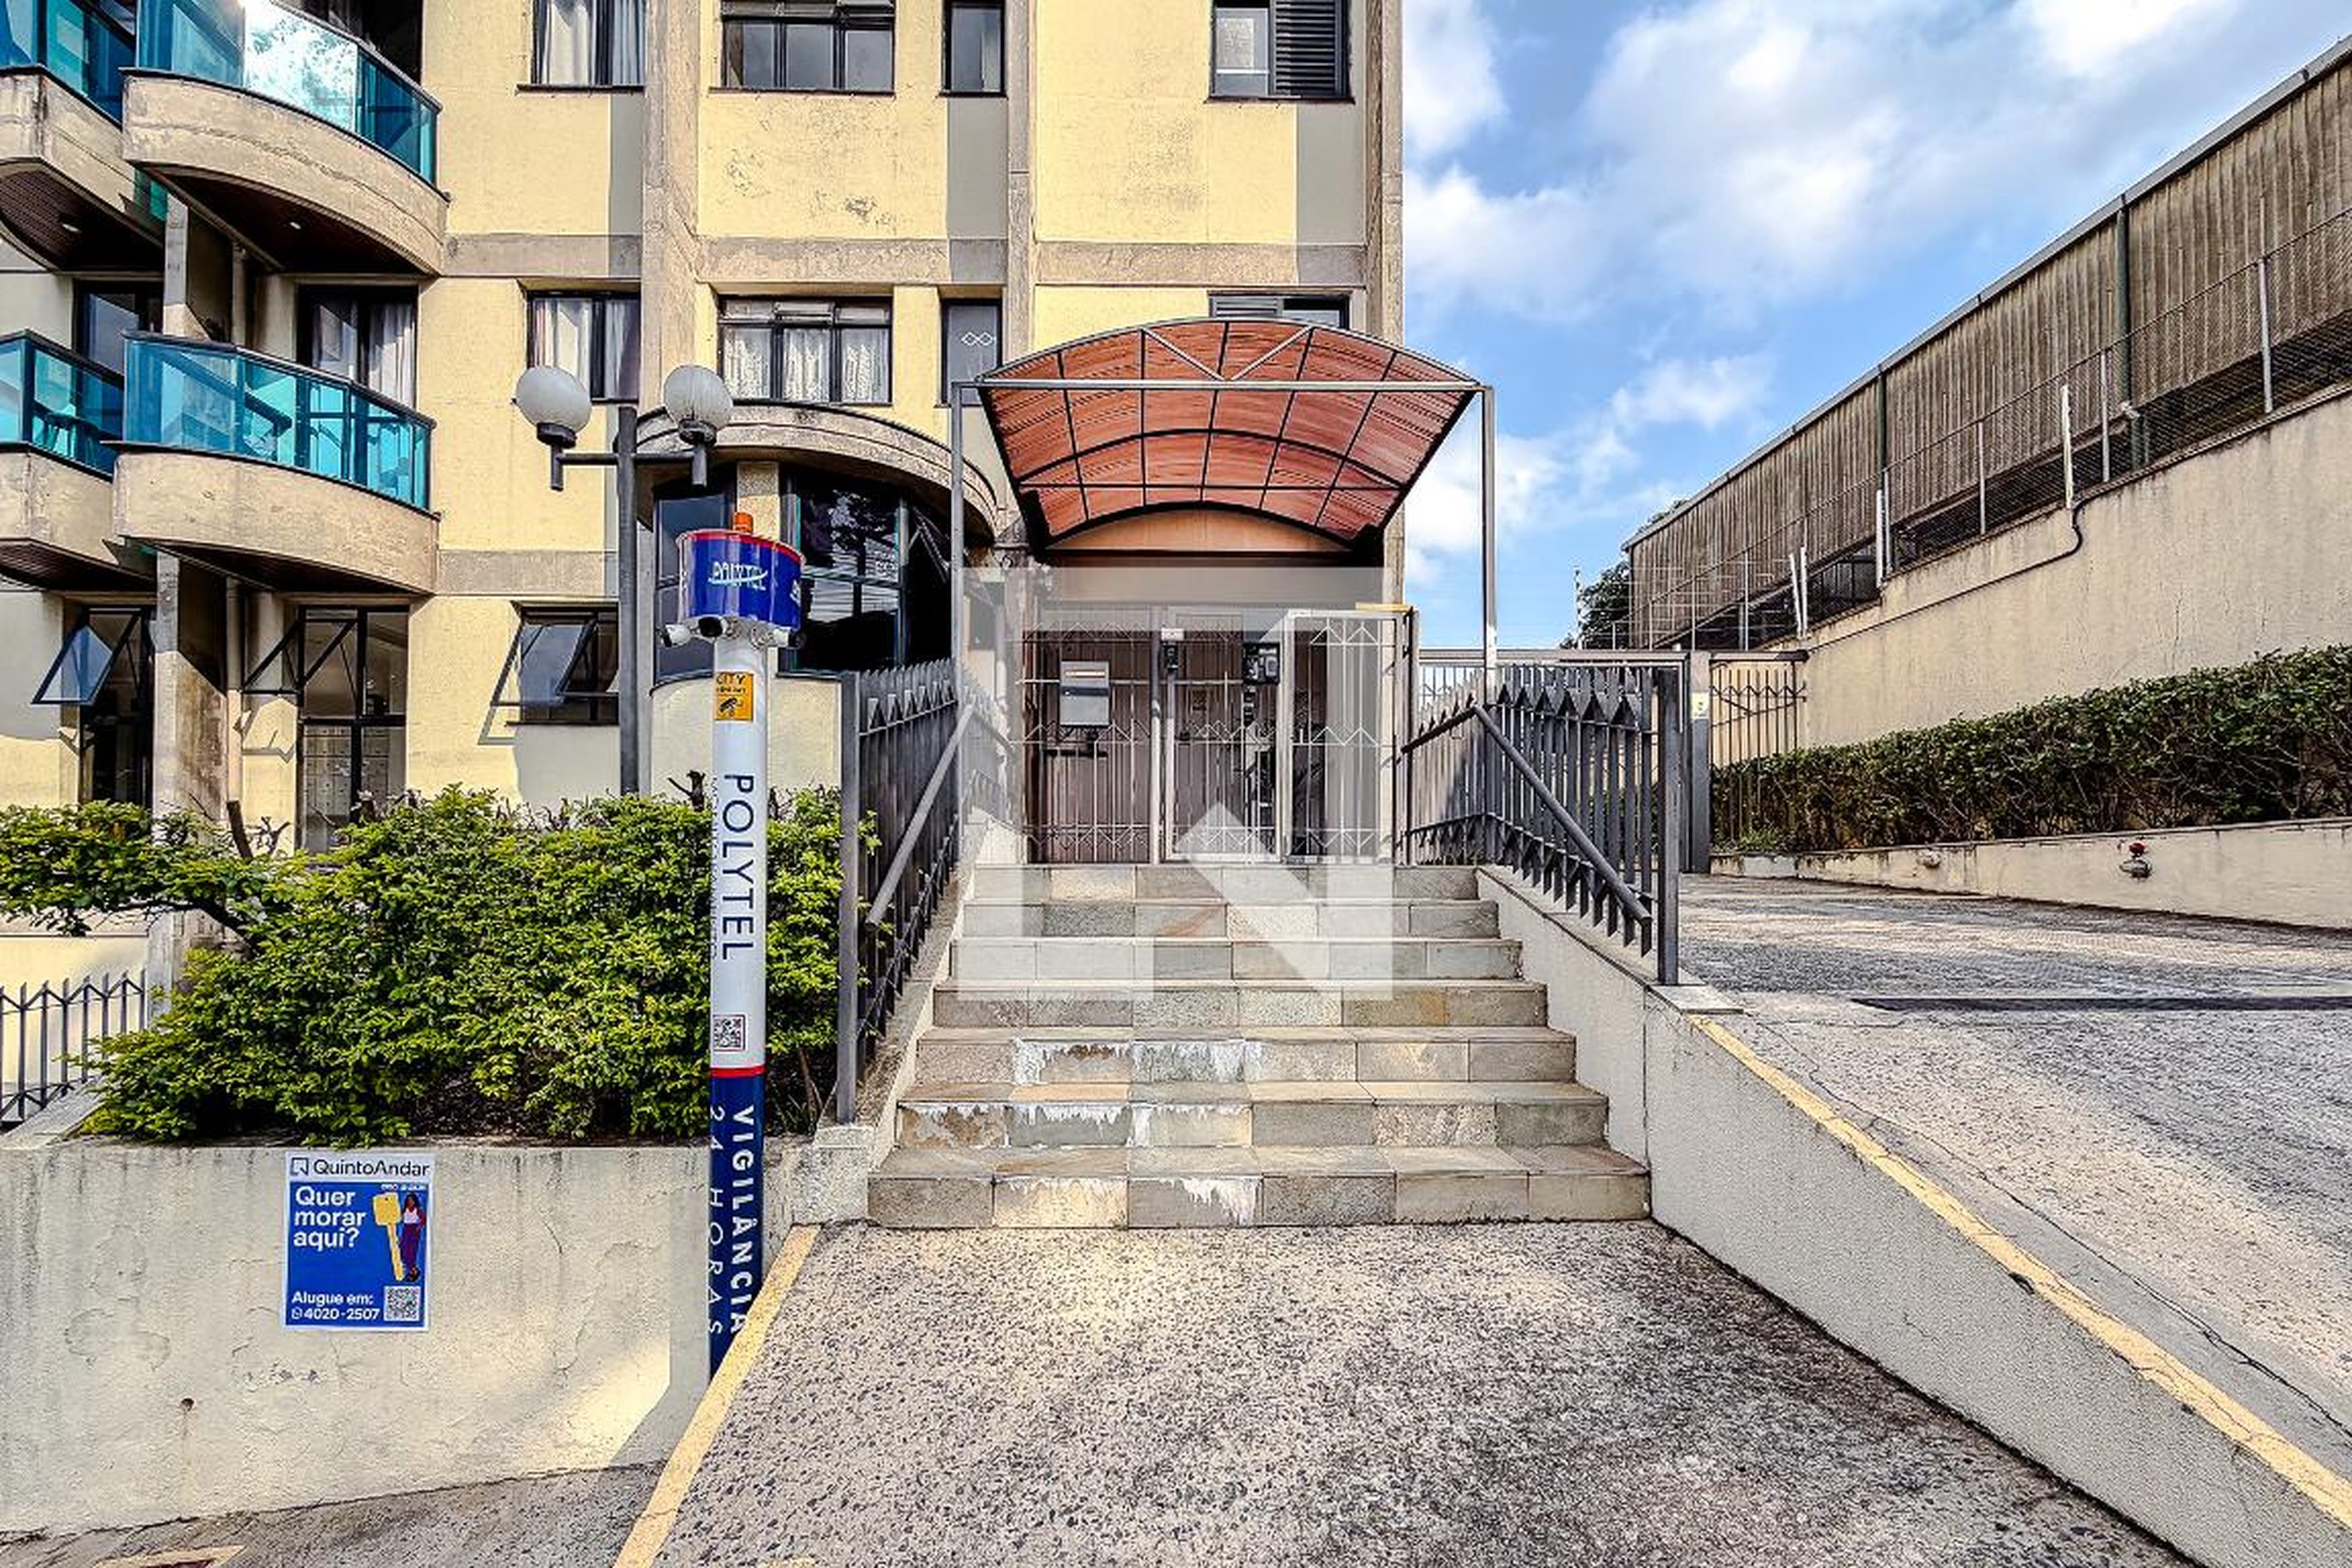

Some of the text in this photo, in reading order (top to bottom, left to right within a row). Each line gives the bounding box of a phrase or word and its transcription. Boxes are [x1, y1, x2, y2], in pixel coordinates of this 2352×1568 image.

[722, 774, 754, 960] POLYTEL
[313, 1159, 429, 1176] QuintoAndar
[295, 1186, 355, 1206] Quer
[294, 1211, 366, 1226] morar
[293, 1227, 360, 1251] aqui?
[292, 1291, 374, 1307] Alugue em:
[304, 1308, 380, 1320] 4020-2507
